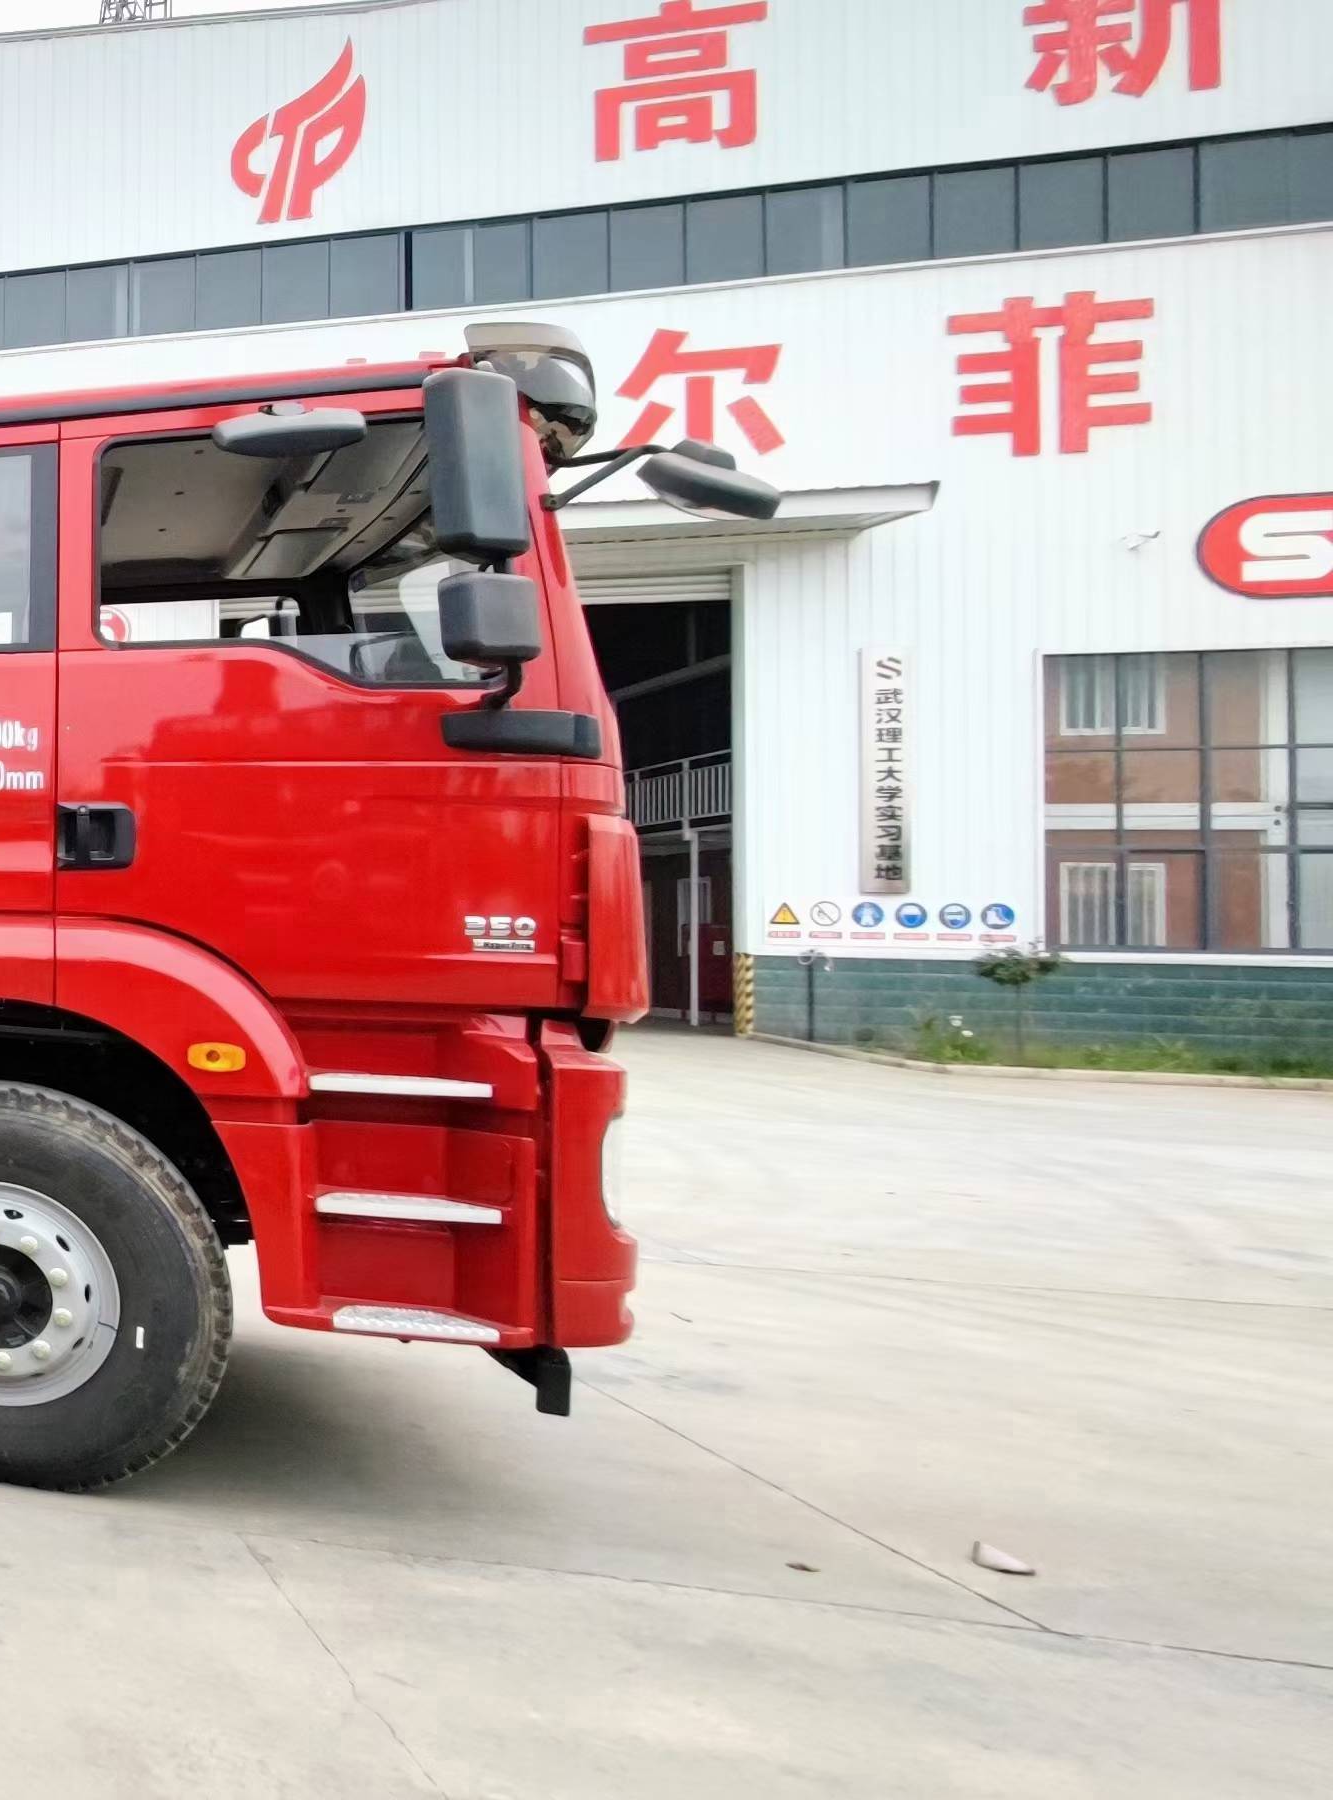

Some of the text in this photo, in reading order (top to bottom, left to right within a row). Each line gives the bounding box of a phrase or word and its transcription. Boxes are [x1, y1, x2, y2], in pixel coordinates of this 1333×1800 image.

[874, 687, 903, 881] 武汉理工大学实习基地
